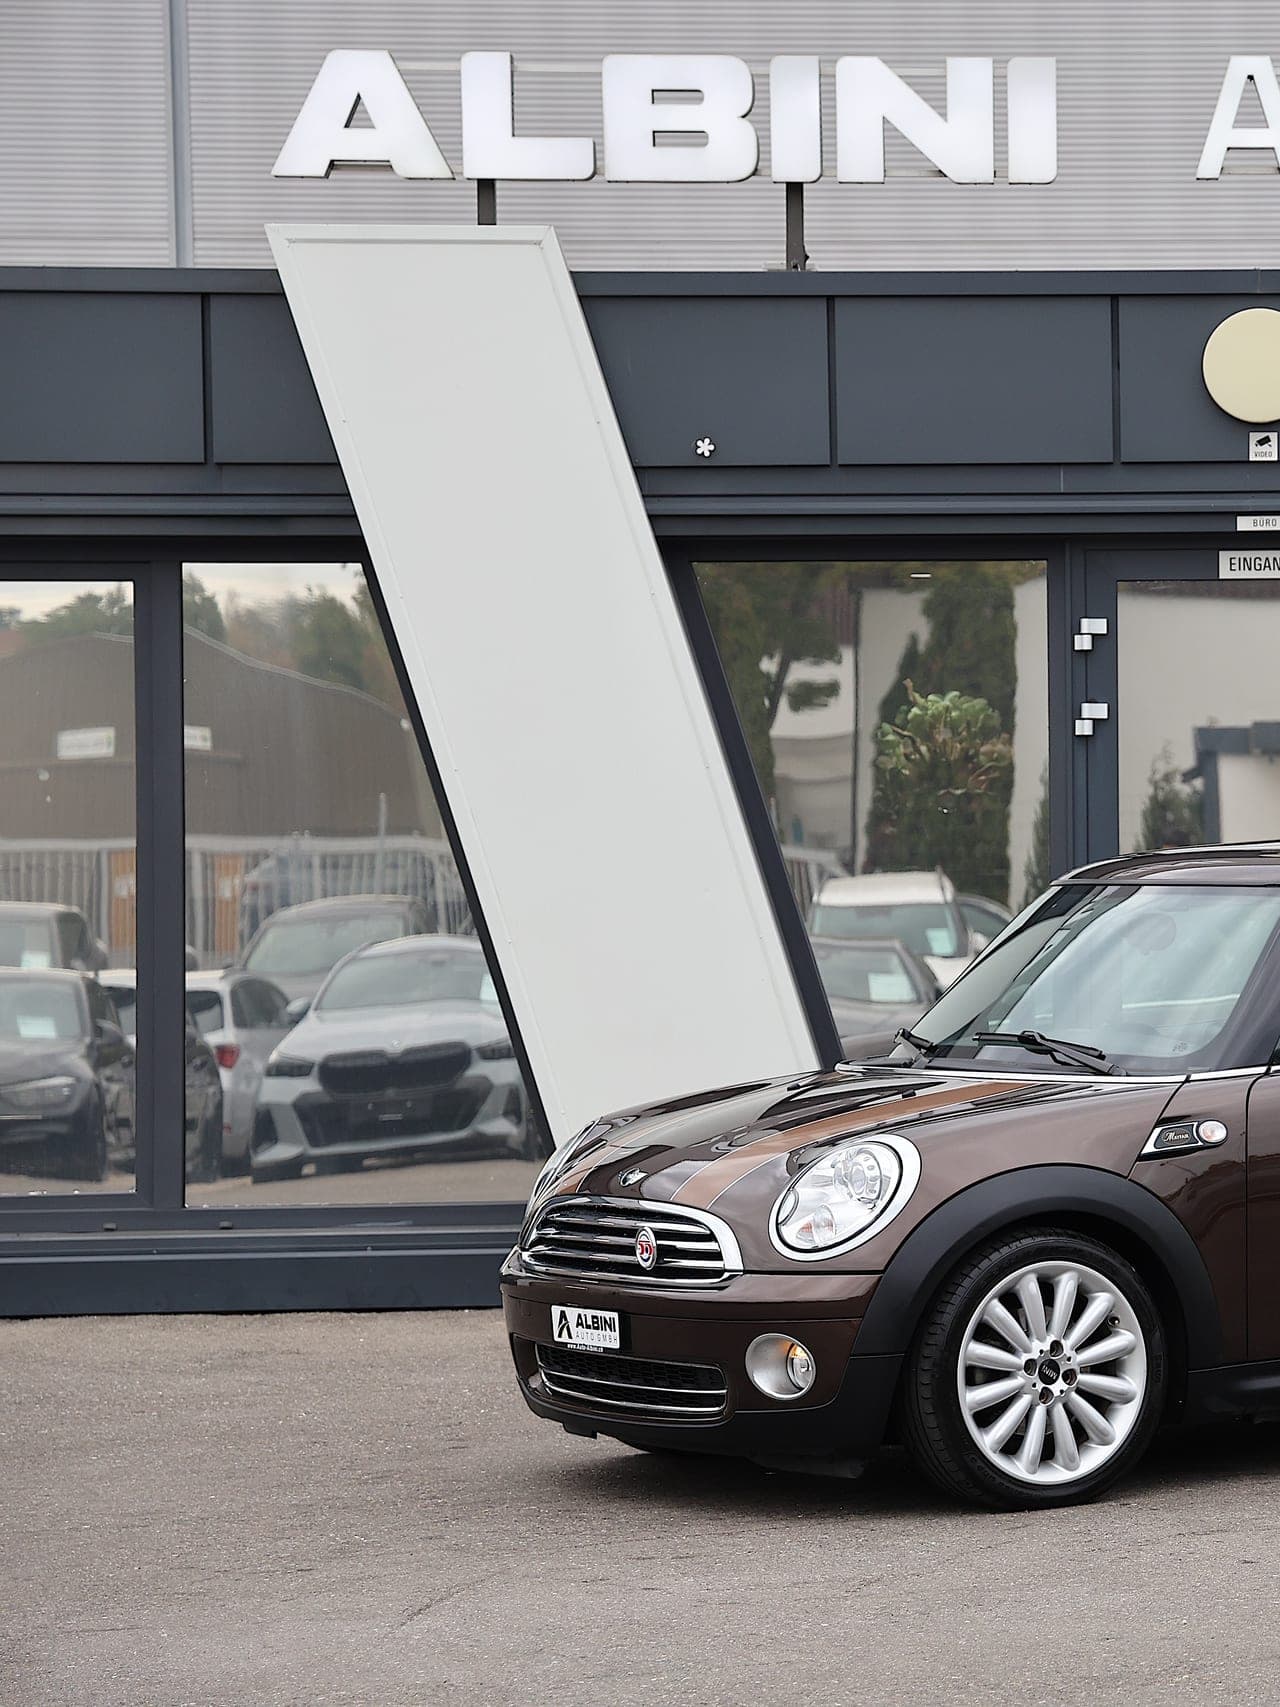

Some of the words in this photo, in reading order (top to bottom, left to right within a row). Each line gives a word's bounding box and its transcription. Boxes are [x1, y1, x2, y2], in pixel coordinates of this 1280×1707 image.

[271, 49, 1057, 184] ALBINI
[1252, 517, 1278, 528] BÜRO
[575, 1312, 616, 1332] ALBINI
